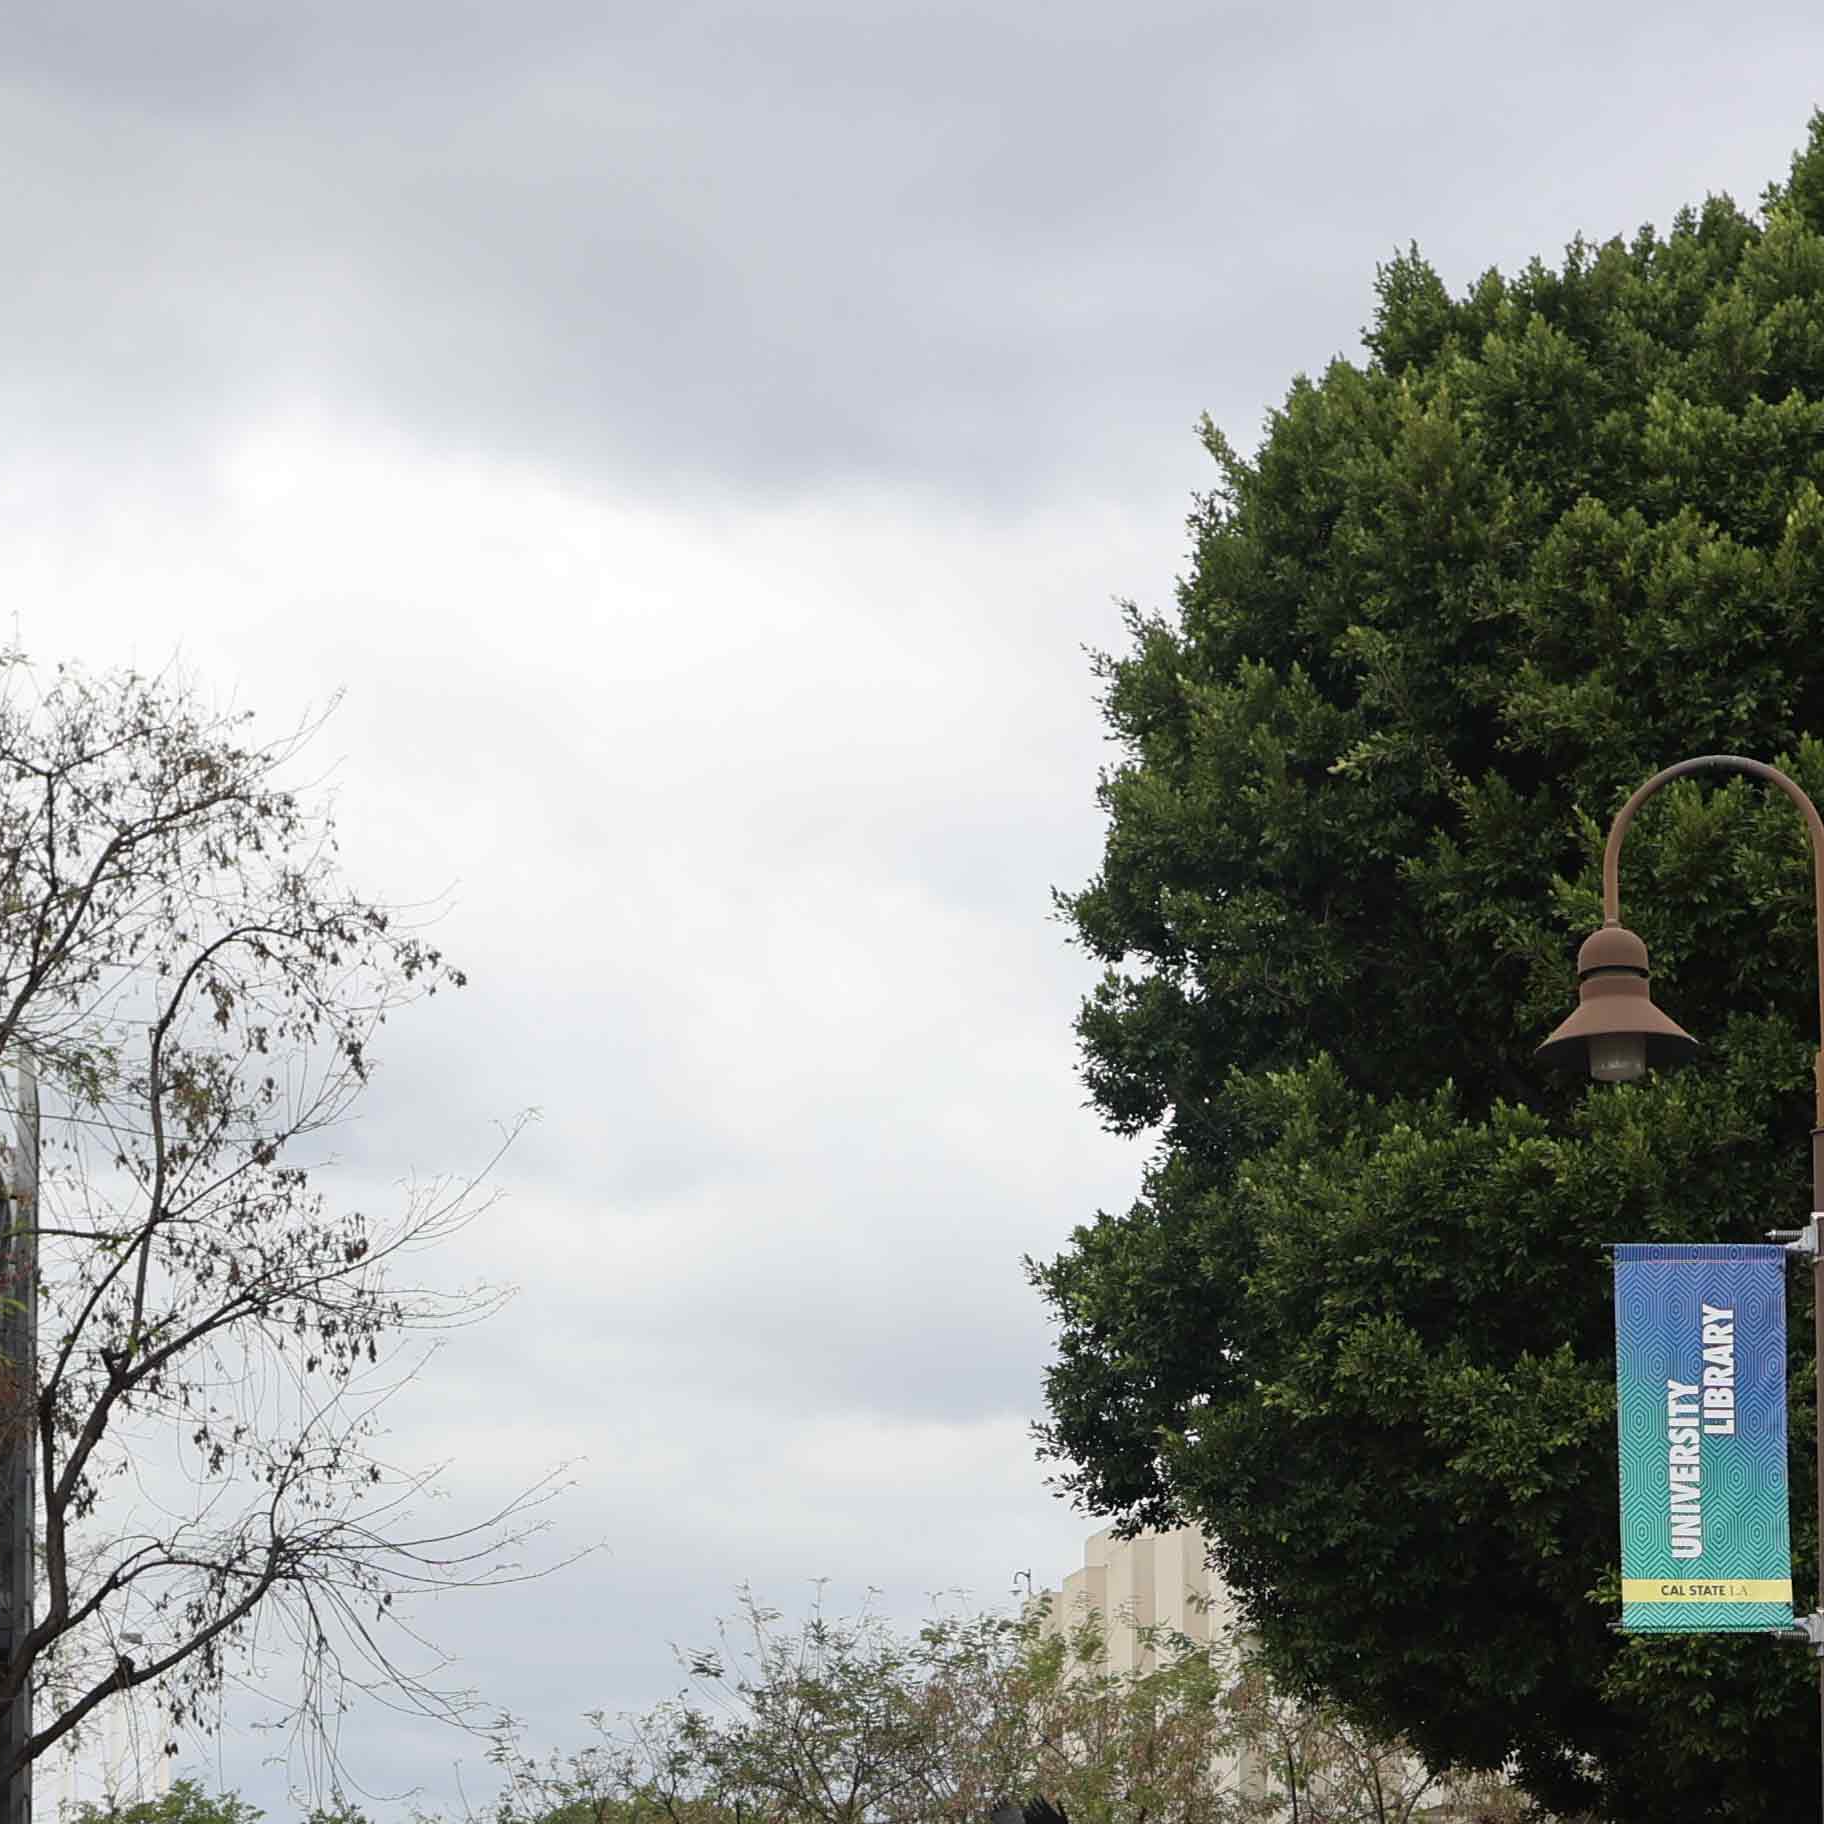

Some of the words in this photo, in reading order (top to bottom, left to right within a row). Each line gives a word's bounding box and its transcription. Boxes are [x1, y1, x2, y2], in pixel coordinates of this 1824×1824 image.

[1701, 1303, 1735, 1436] LIBRARY
[1666, 1379, 1703, 1560] UNIVERSITY
[1661, 1585, 1685, 1596] CAL
[1688, 1585, 1726, 1596] STATE
